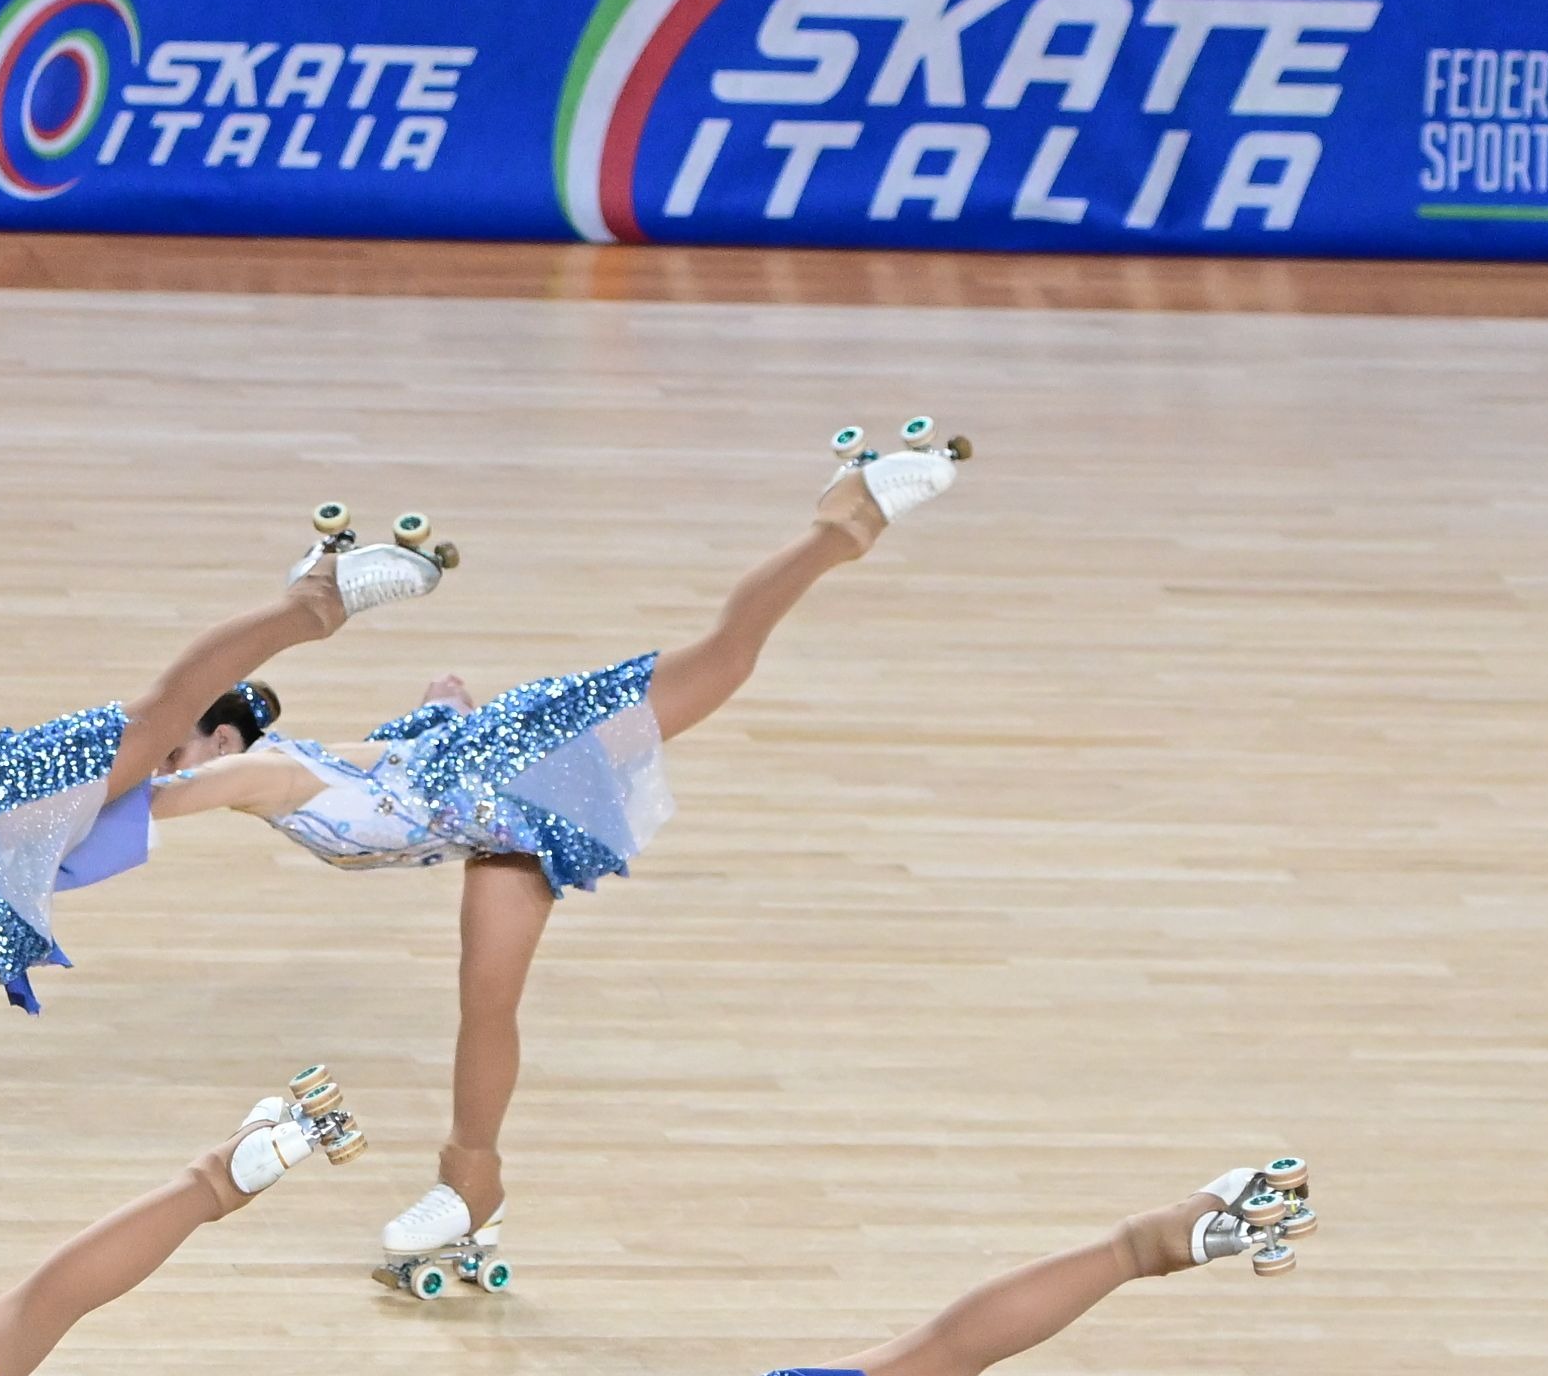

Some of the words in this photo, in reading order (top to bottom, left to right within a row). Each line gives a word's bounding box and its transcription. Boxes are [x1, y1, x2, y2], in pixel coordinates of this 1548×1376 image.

[122, 41, 477, 111] SKATE
[96, 110, 449, 172] ITALIA
[663, 119, 1323, 231] ITALIA
